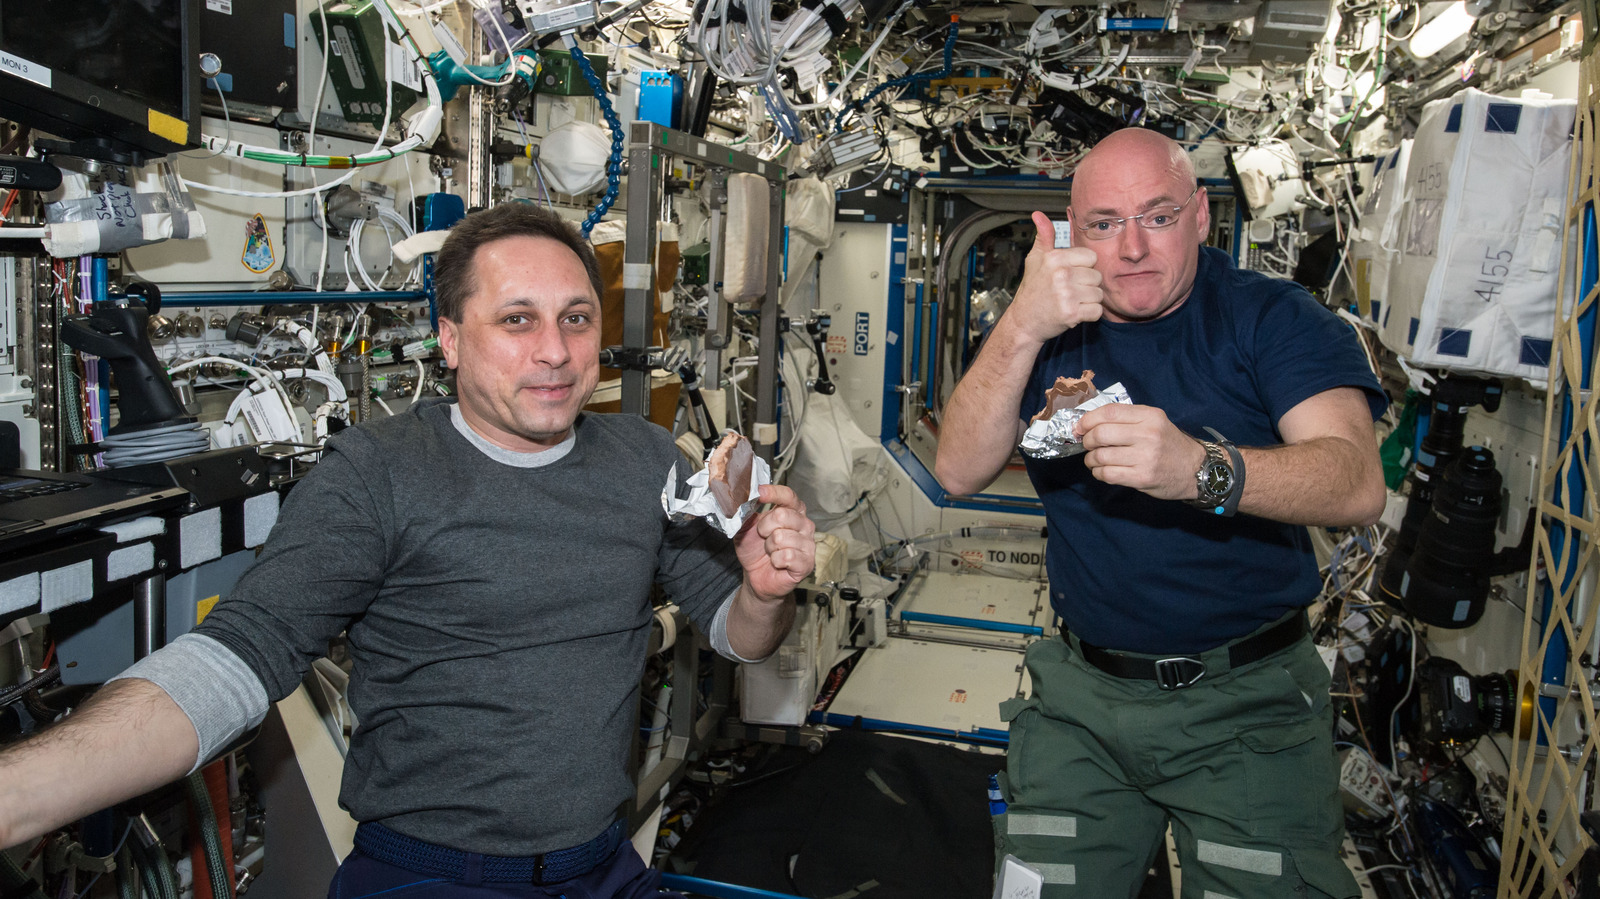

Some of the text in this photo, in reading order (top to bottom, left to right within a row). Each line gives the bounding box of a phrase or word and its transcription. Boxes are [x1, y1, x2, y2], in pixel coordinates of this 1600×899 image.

[2, 57, 28, 73] MON 3
[1417, 162, 1444, 193] 4155
[1474, 246, 1513, 302] 4155
[855, 313, 869, 354] PORT
[988, 550, 1006, 563] TO
[1010, 552, 1045, 565] NOD
